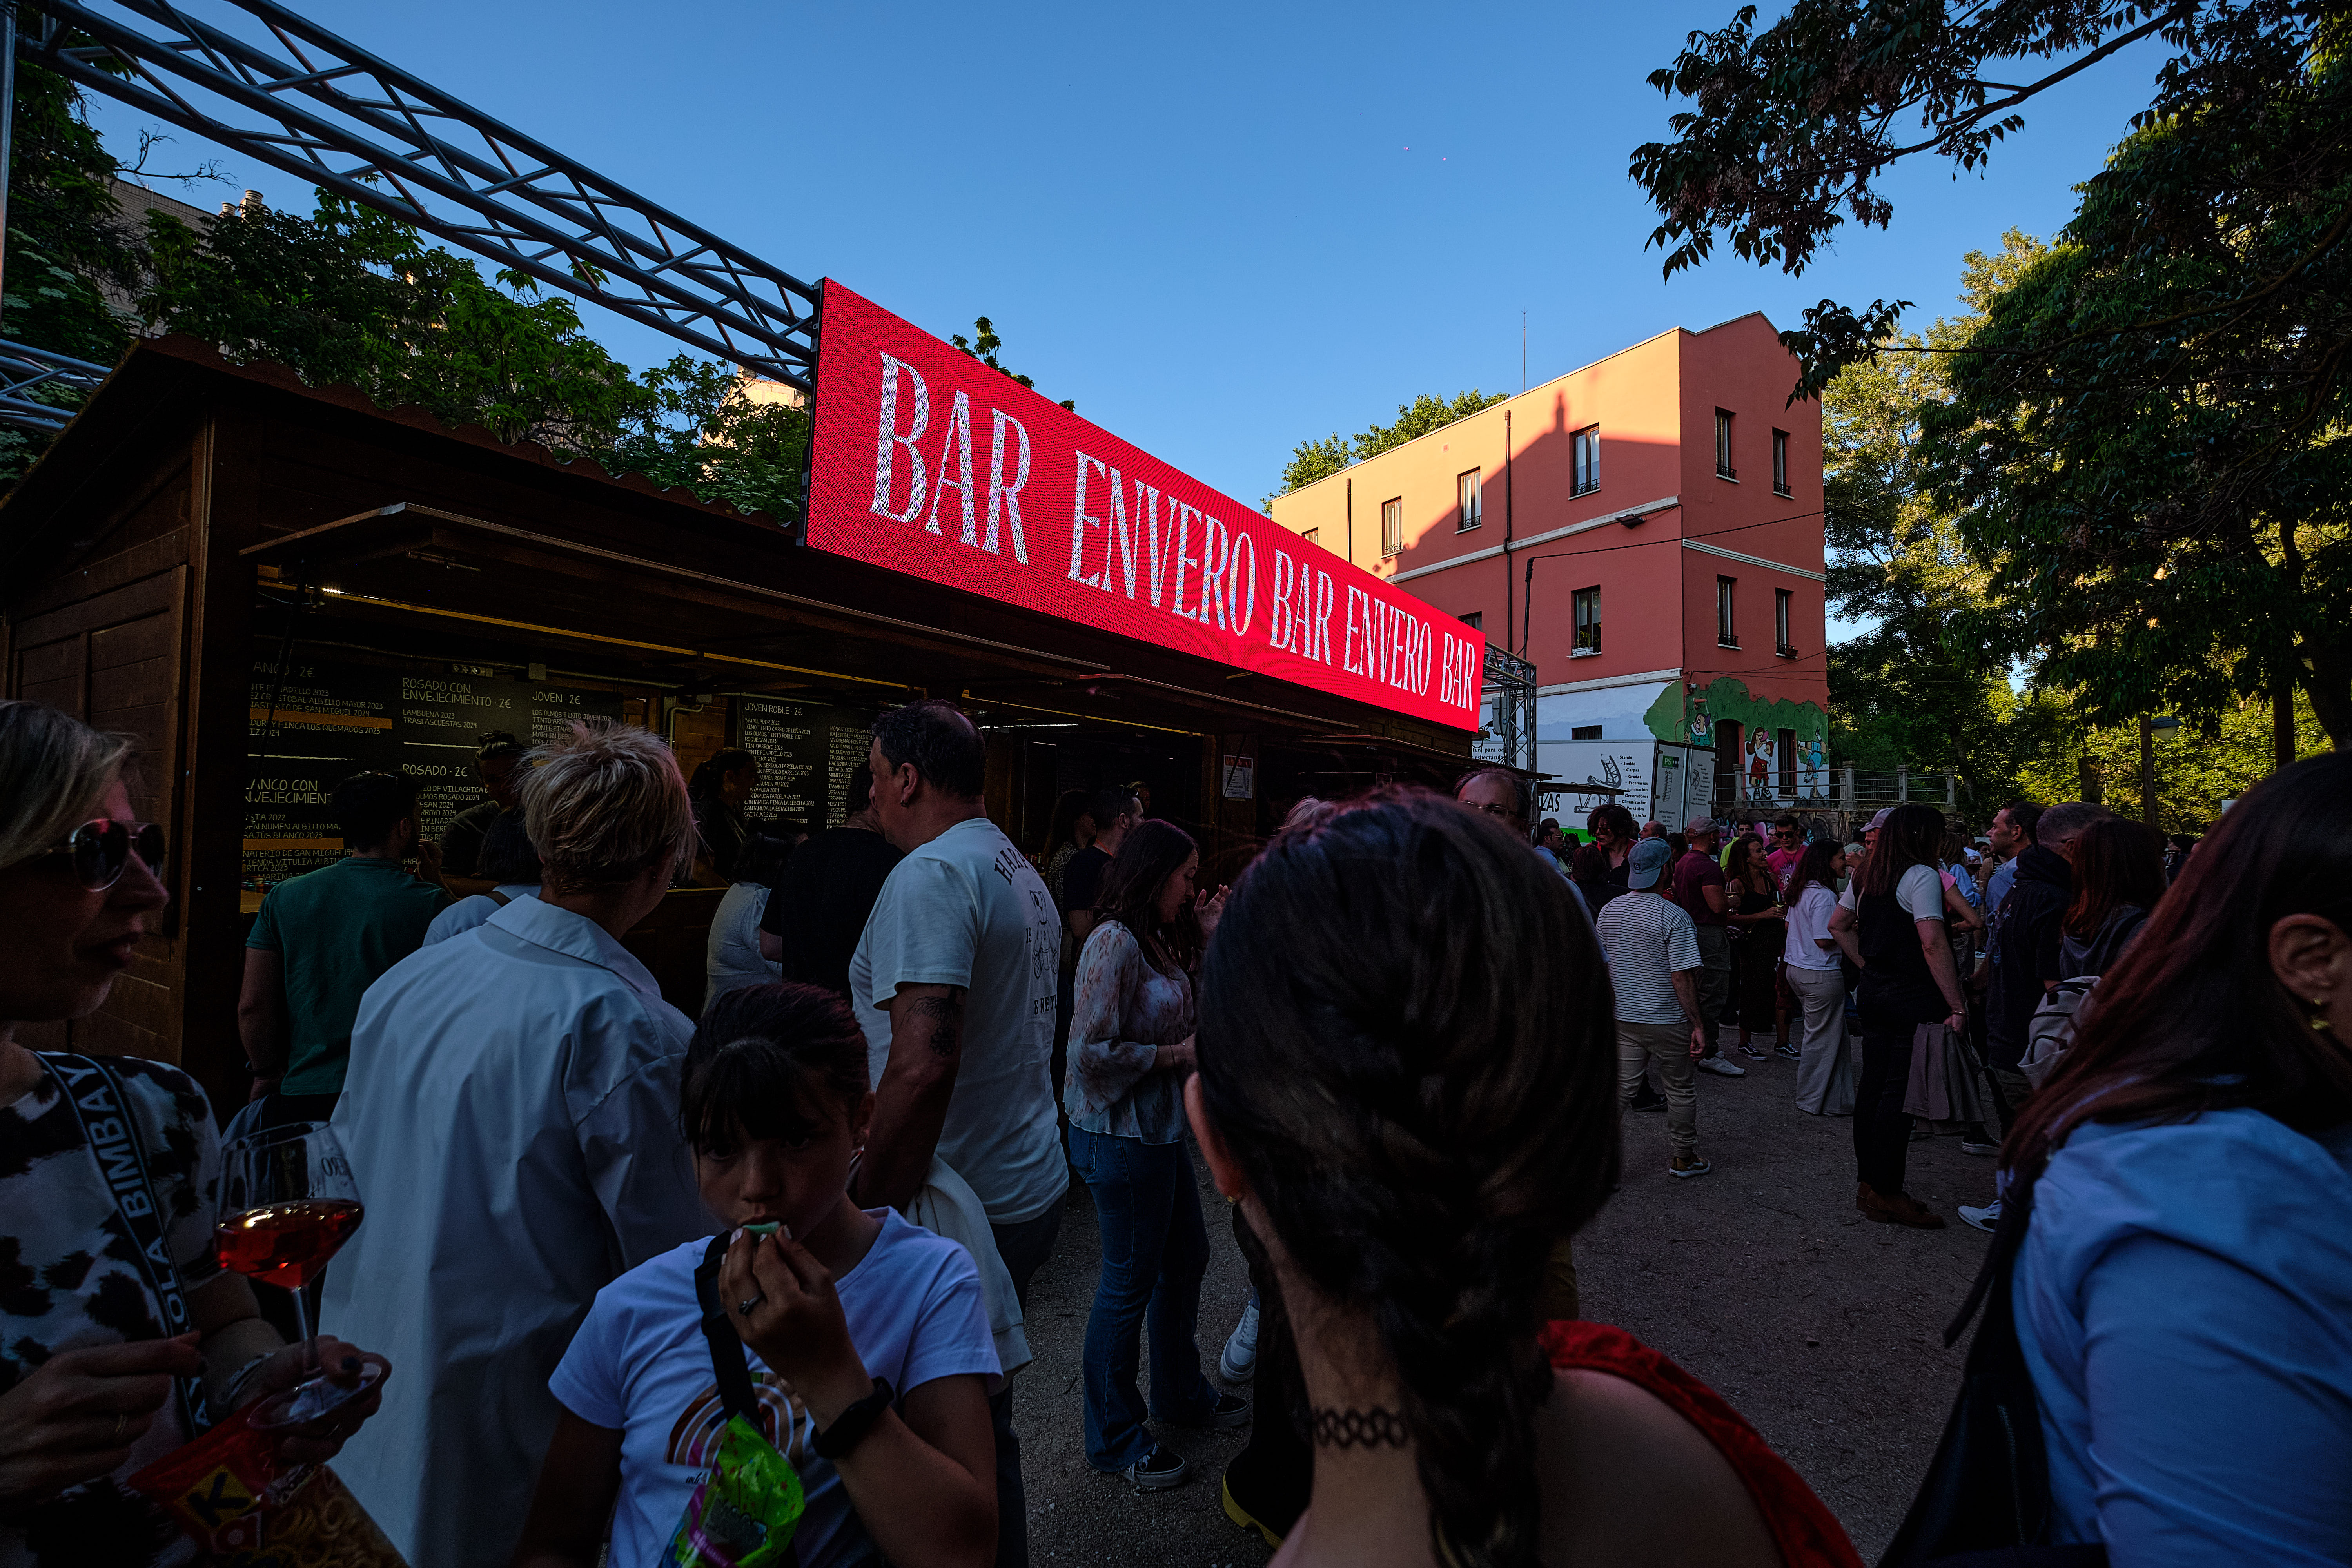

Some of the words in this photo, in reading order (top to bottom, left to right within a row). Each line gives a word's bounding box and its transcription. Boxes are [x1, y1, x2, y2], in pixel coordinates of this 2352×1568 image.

[869, 351, 1031, 565] BAR
[1067, 449, 1256, 637] ENVERO
[1270, 548, 1334, 666] BAR
[1343, 584, 1432, 697] ENVERO
[1440, 632, 1475, 711] BAR
[402, 677, 447, 691] ROSADO
[449, 682, 471, 694] CON
[309, 697, 341, 706] ALBILLO
[342, 700, 366, 708] MAYOR
[367, 702, 383, 710] 2023
[402, 689, 492, 707] ENVEJECIMIENTO
[499, 698, 512, 709] 2€
[532, 691, 563, 703] JOVEN
[569, 695, 581, 705] 2€
[304, 705, 321, 713] SAN
[323, 706, 352, 716] MIGUEL
[402, 708, 440, 718] LAMBUENA
[745, 703, 768, 712] JOVEN
[769, 705, 790, 715] ROBLE
[278, 721, 306, 730] FINCA
[323, 724, 364, 733] QUEMADOS
[403, 717, 462, 728] TRASLASCUESTAS
[402, 764, 447, 776] ROSADO
[454, 766, 468, 777] 2€
[292, 780, 318, 791] CON
